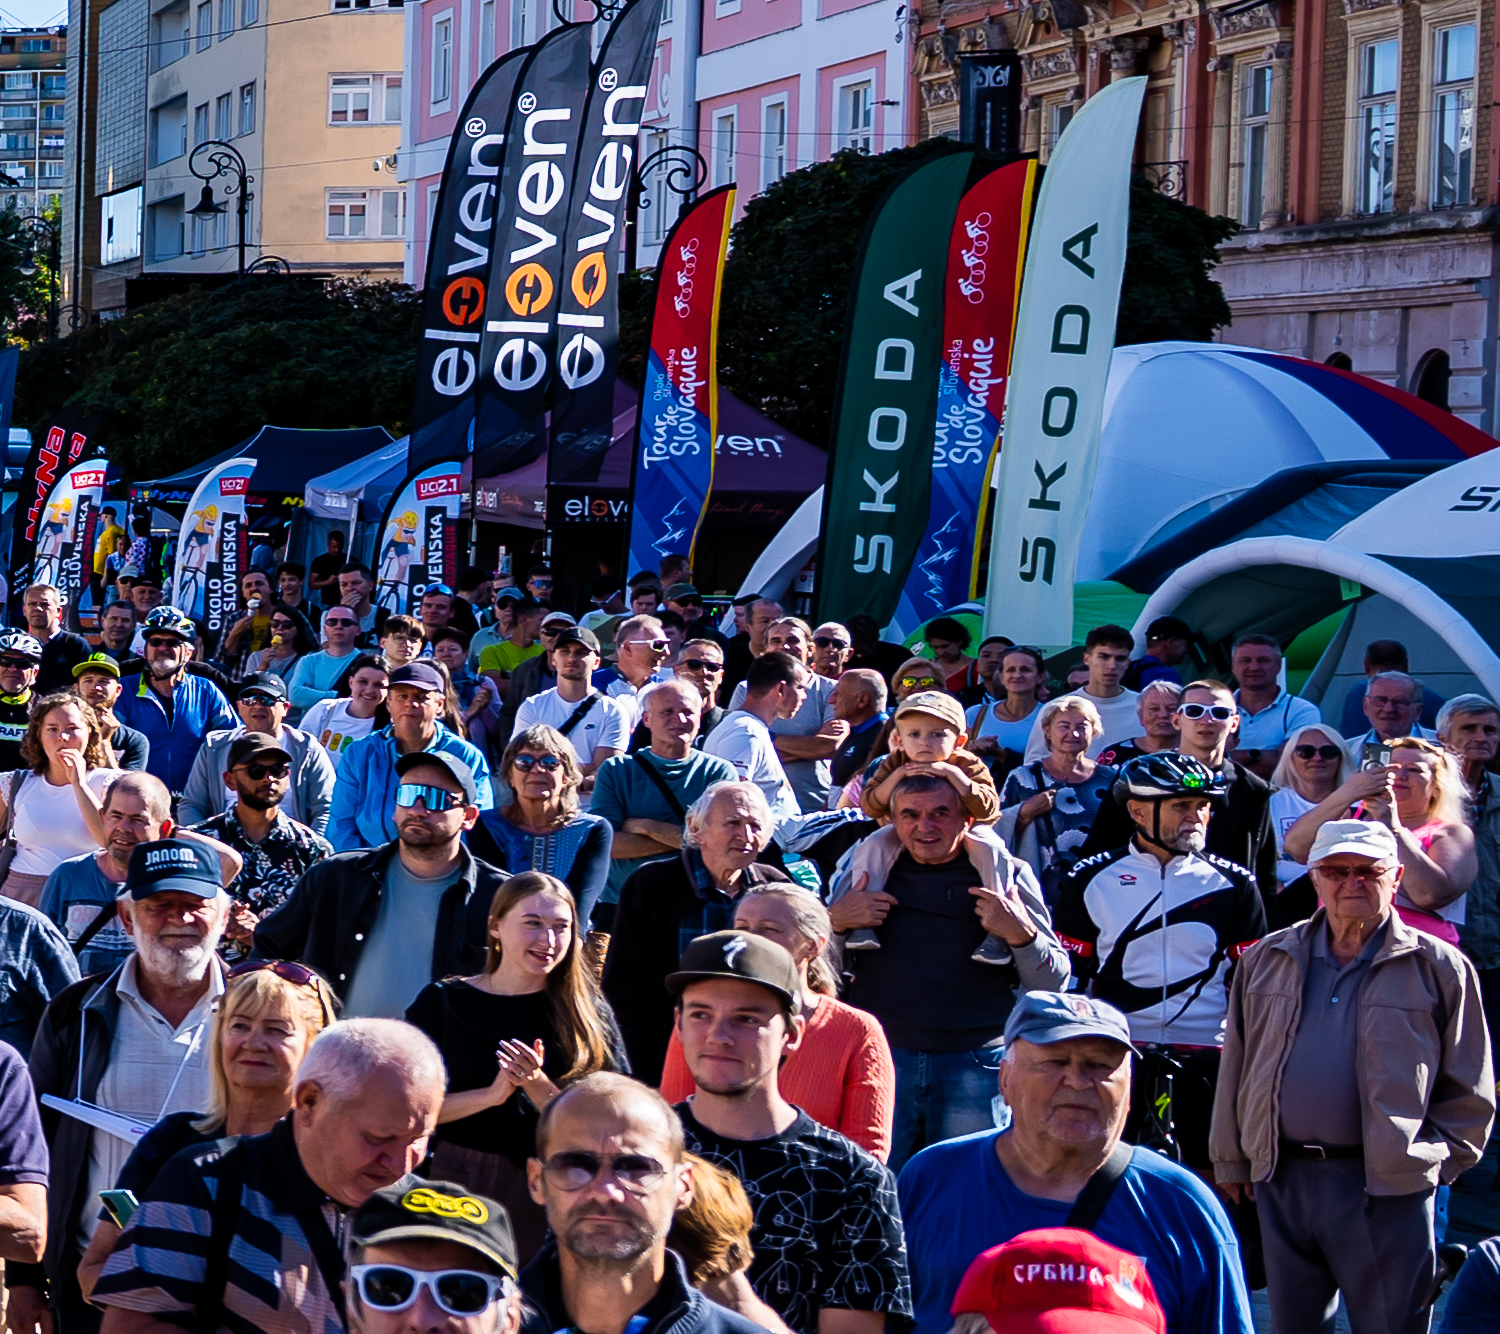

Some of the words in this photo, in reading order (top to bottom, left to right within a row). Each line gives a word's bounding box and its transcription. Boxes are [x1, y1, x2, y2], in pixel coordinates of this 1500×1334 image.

[669, 345, 706, 456] Slovaquie
[943, 338, 963, 396] Slovenska
[948, 336, 1003, 464] Slovaquie
[662, 404, 678, 426] de
[853, 268, 922, 574] ŠKODA
[947, 403, 966, 429] de
[1019, 222, 1099, 586] ŠKODA
[643, 414, 669, 469] Tour
[69, 501, 89, 588] SLOVENSKA
[223, 520, 237, 612] SLOVENSKA
[429, 514, 443, 586] VENSKA
[208, 578, 222, 630] OKOLO
[1013, 1263, 1104, 1287] СРБИЈА
